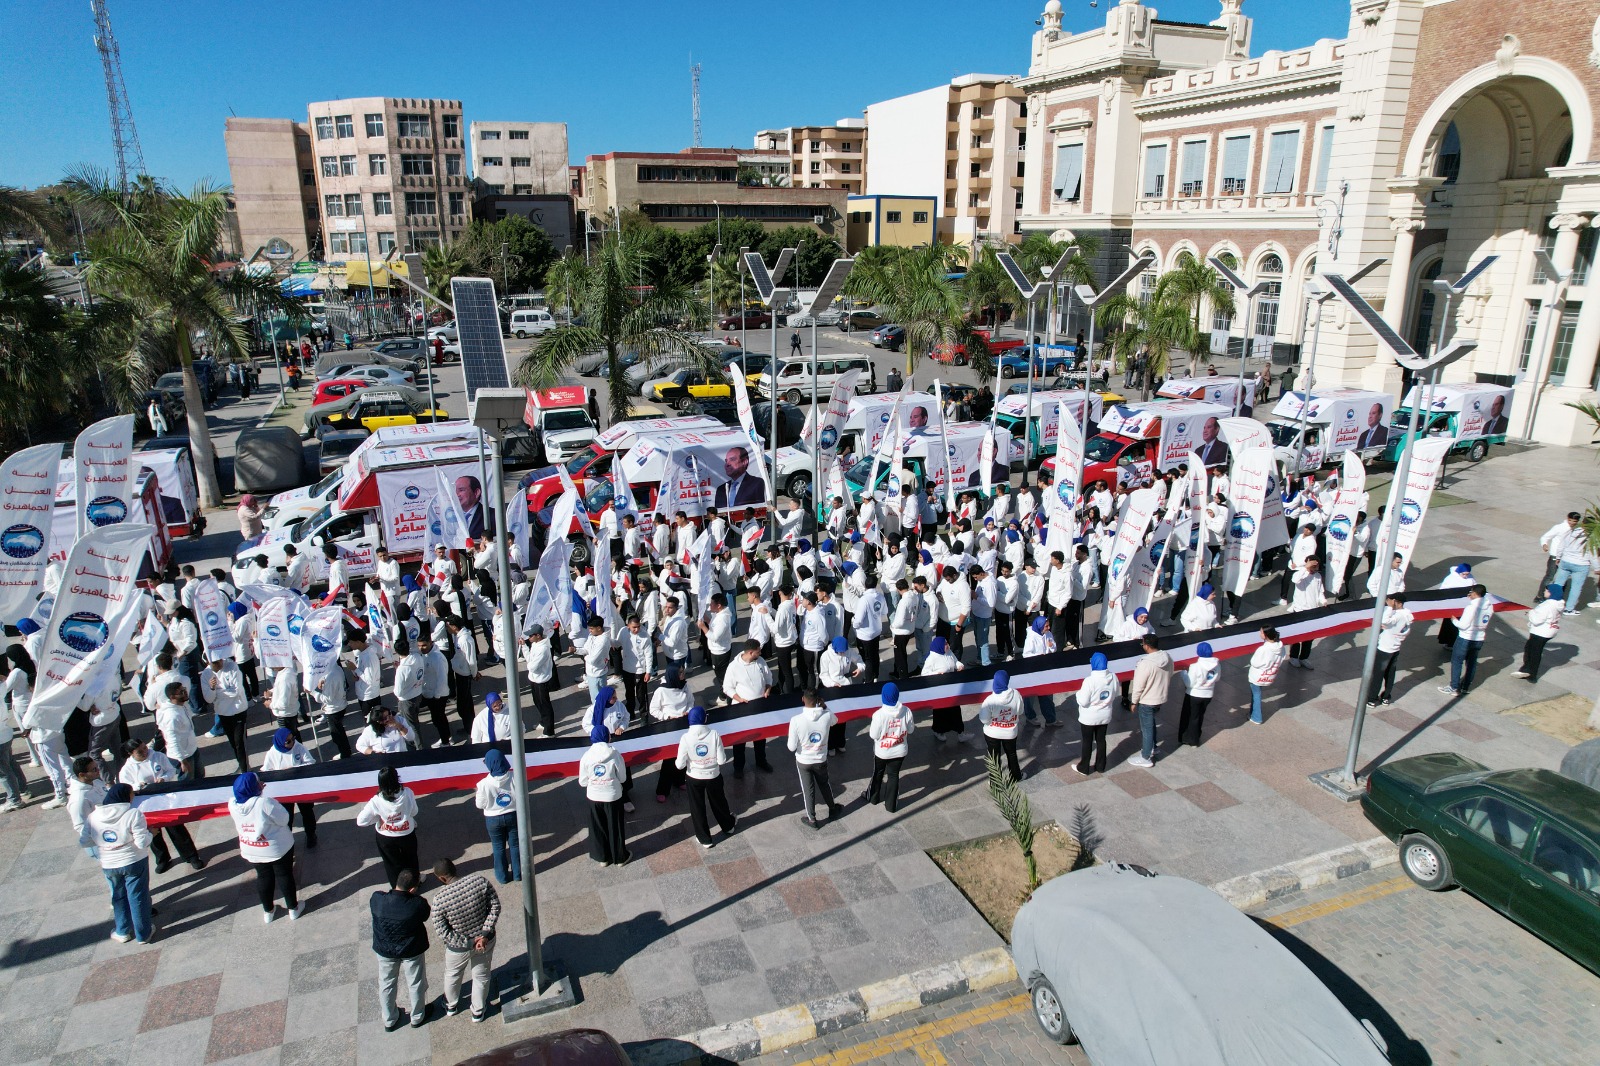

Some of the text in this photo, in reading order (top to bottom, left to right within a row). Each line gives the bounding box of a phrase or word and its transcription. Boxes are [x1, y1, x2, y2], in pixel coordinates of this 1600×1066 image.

[1167, 441, 1193, 453] افطار
[83, 457, 128, 467] العمل
[680, 477, 711, 490] افطا
[4, 486, 52, 496] العمل
[679, 489, 712, 499] مساف
[394, 522, 427, 537] سافر
[346, 557, 372, 566] مساف
[74, 565, 130, 584] العمل
